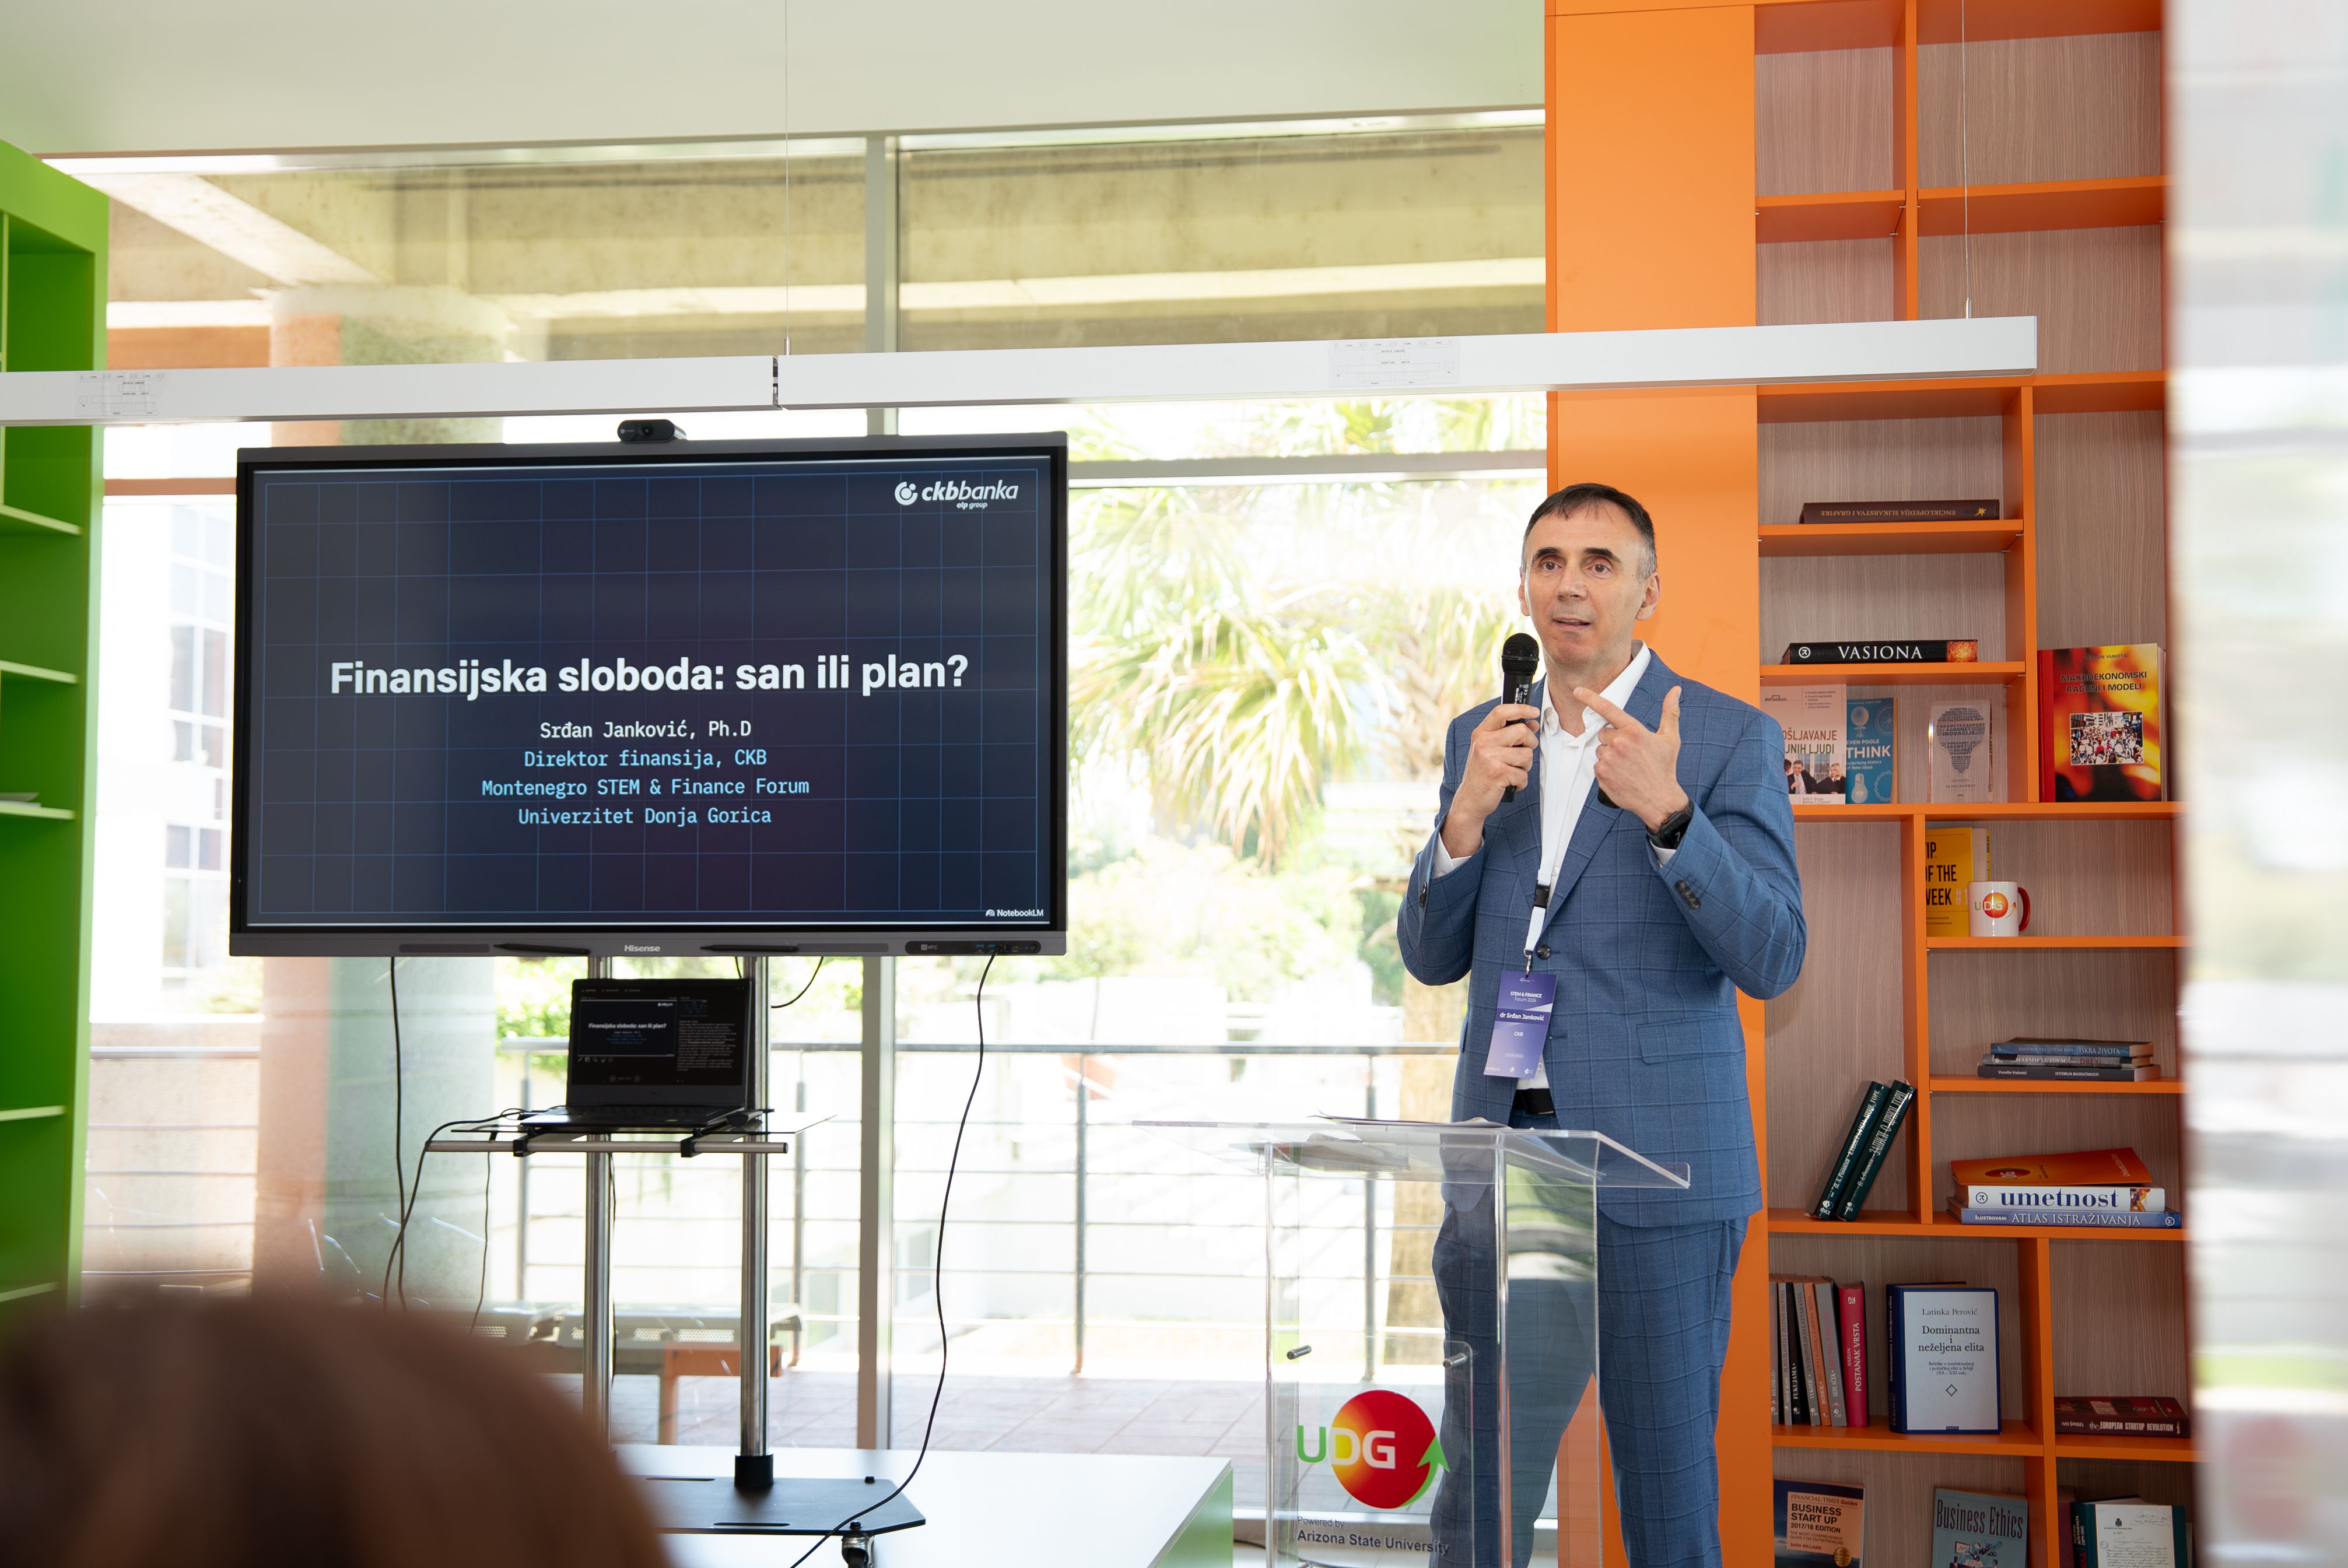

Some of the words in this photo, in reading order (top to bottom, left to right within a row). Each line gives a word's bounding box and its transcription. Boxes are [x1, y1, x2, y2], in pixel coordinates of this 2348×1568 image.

[921, 479, 1019, 501] ckbbanka
[956, 501, 968, 510] otp
[1838, 646, 1923, 660] VASIONA
[331, 658, 547, 701] Finansijska
[558, 657, 724, 692] sloboda:
[735, 664, 805, 690] san
[817, 655, 849, 689] ili
[862, 654, 969, 696] plan?
[2060, 671, 2147, 682] MAKROEKONOMSKI
[2066, 683, 2100, 693] RAČUNI
[2108, 683, 2142, 692] MODELI
[539, 722, 593, 738] Srđan
[602, 720, 696, 739] Janković,
[708, 720, 752, 737] Ph.D
[1809, 743, 1834, 754] LJUDI
[1846, 745, 1891, 759] THINK
[524, 750, 608, 767] Direktor
[619, 749, 723, 769] finansija,
[734, 749, 767, 765] CKB
[482, 780, 587, 799] Montenegro
[597, 780, 640, 795] STEM
[649, 779, 661, 795] &
[672, 778, 745, 794] Finance
[756, 778, 809, 794] Forum
[518, 808, 634, 825] Univerzitet
[644, 807, 698, 827] Donja
[707, 806, 772, 823] Gorica
[1936, 864, 1957, 882] THE
[997, 908, 1044, 917] NotebookLM
[1974, 900, 2003, 911] UDG
[1999, 1188, 2119, 1208] umetnost
[2011, 1213, 2048, 1223] ATLAS
[2052, 1211, 2141, 1227] ISTRAŽIVANJA
[1852, 1323, 1860, 1348] VRSTA
[1922, 1325, 1980, 1335] Dominantna
[1949, 1335, 1953, 1344] i
[1918, 1343, 1961, 1354] neželjena
[1964, 1342, 1985, 1352] elita
[1853, 1349, 1862, 1392] POSTANAK
[2100, 1421, 2123, 1430] EUROPEAN
[2125, 1422, 2145, 1430] STARTUP
[2147, 1423, 2174, 1432] REVOLUTION
[1296, 1425, 1396, 1469] UDG
[1791, 1503, 1842, 1516] BUSINESS
[1297, 1516, 1332, 1527] Powered
[1334, 1518, 1344, 1529] by
[1791, 1513, 1821, 1523] START
[1824, 1516, 1837, 1524] UP
[1936, 1499, 1985, 1534] Business
[1989, 1506, 2023, 1539] Ethics
[1815, 1525, 1841, 1534] EDITION
[1297, 1530, 1345, 1544] Arizona
[1349, 1534, 1381, 1548] State
[1385, 1537, 1450, 1556] University
